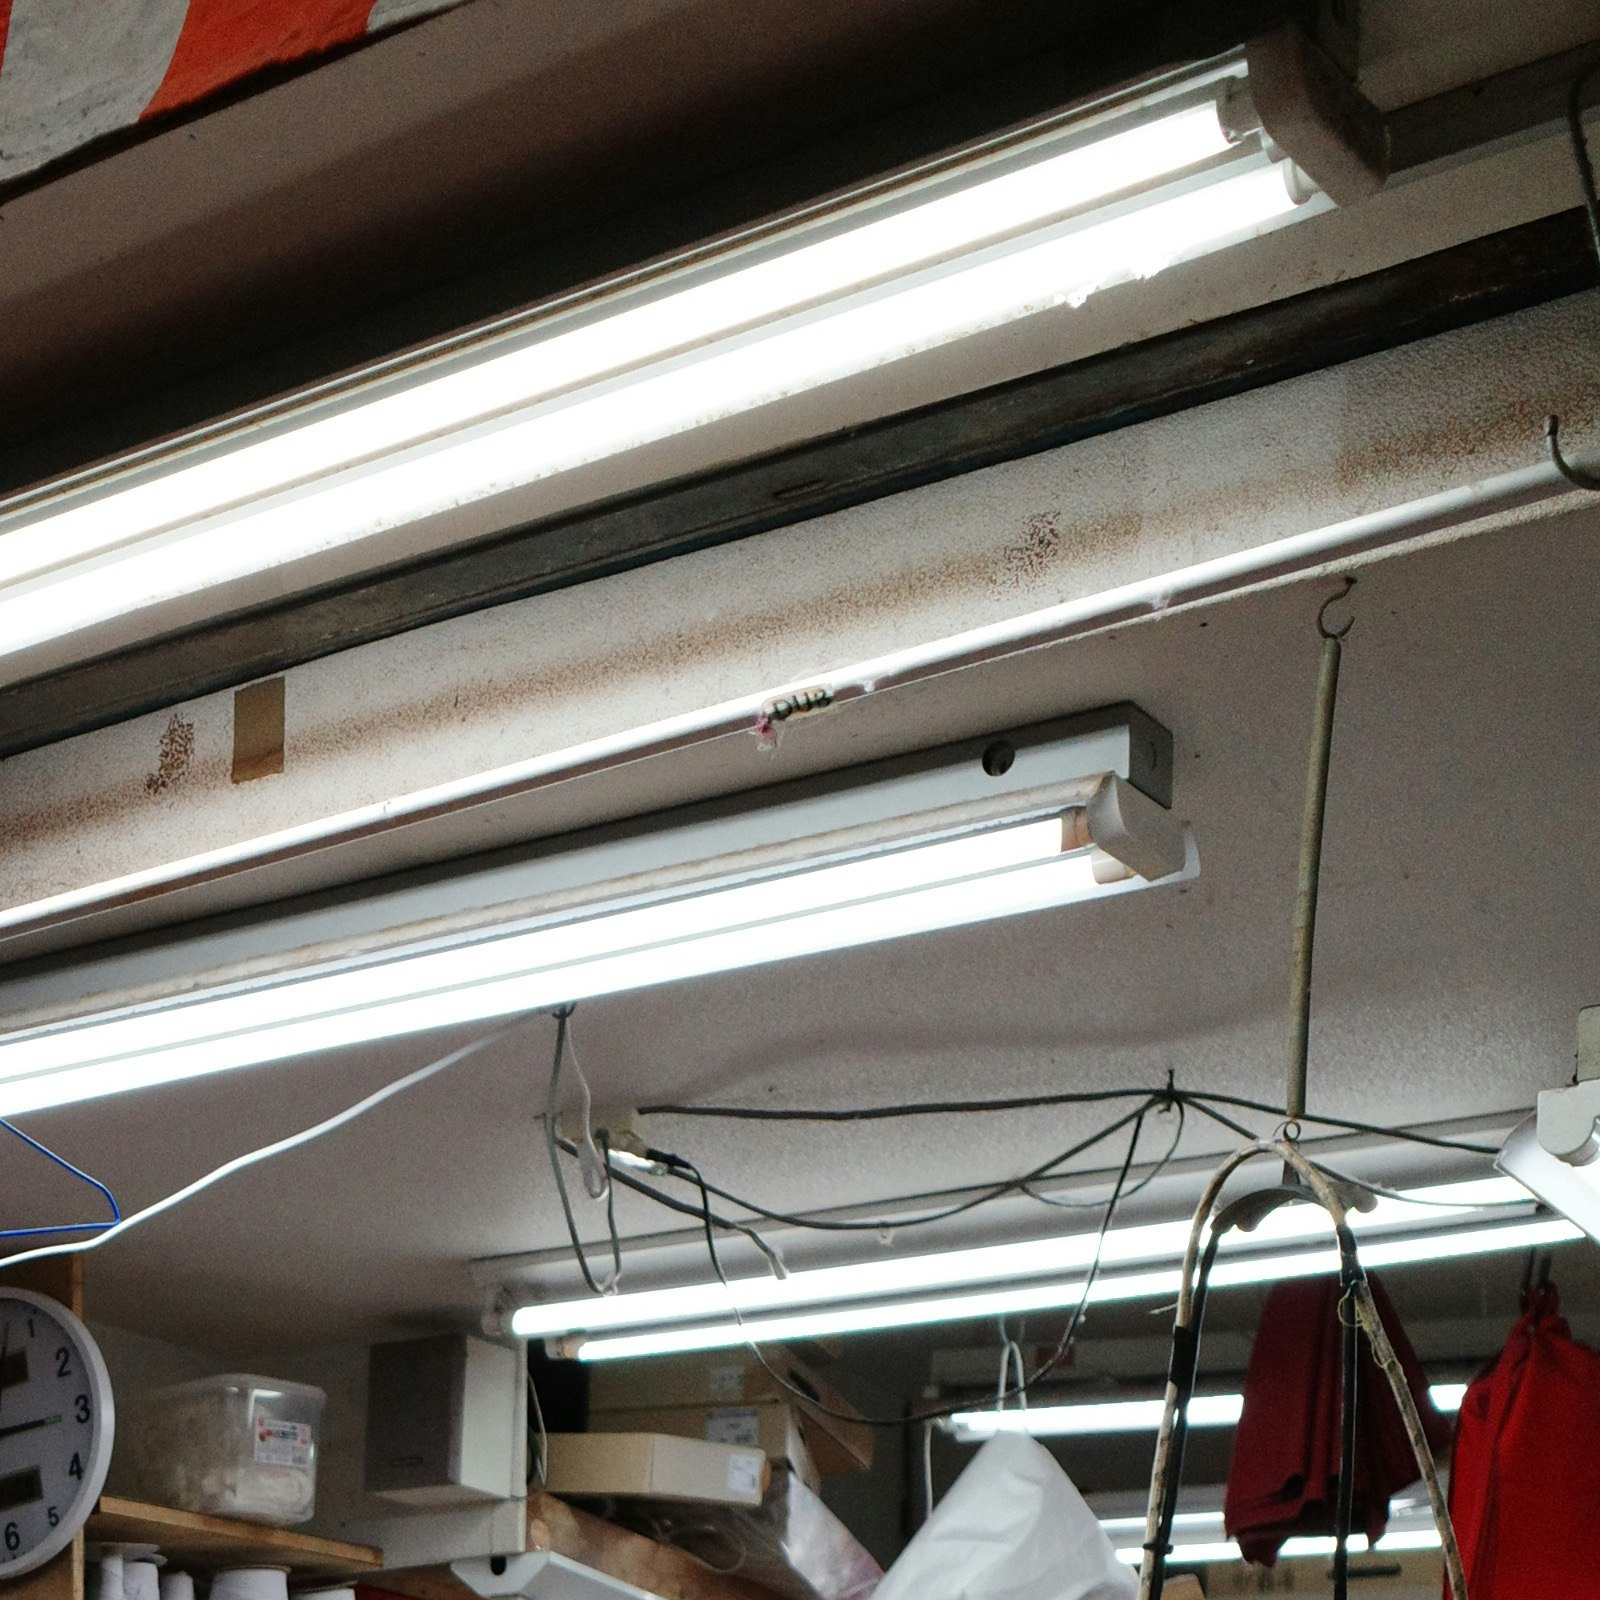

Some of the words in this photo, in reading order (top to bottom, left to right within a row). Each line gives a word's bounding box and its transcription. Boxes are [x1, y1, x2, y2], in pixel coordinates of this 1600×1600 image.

[28, 1319, 36, 1338] 1
[56, 1348, 71, 1378] 2
[75, 1395, 91, 1424] 3
[69, 1452, 84, 1480] 4
[48, 1506, 59, 1527] 5
[5, 1522, 20, 1550] 6
